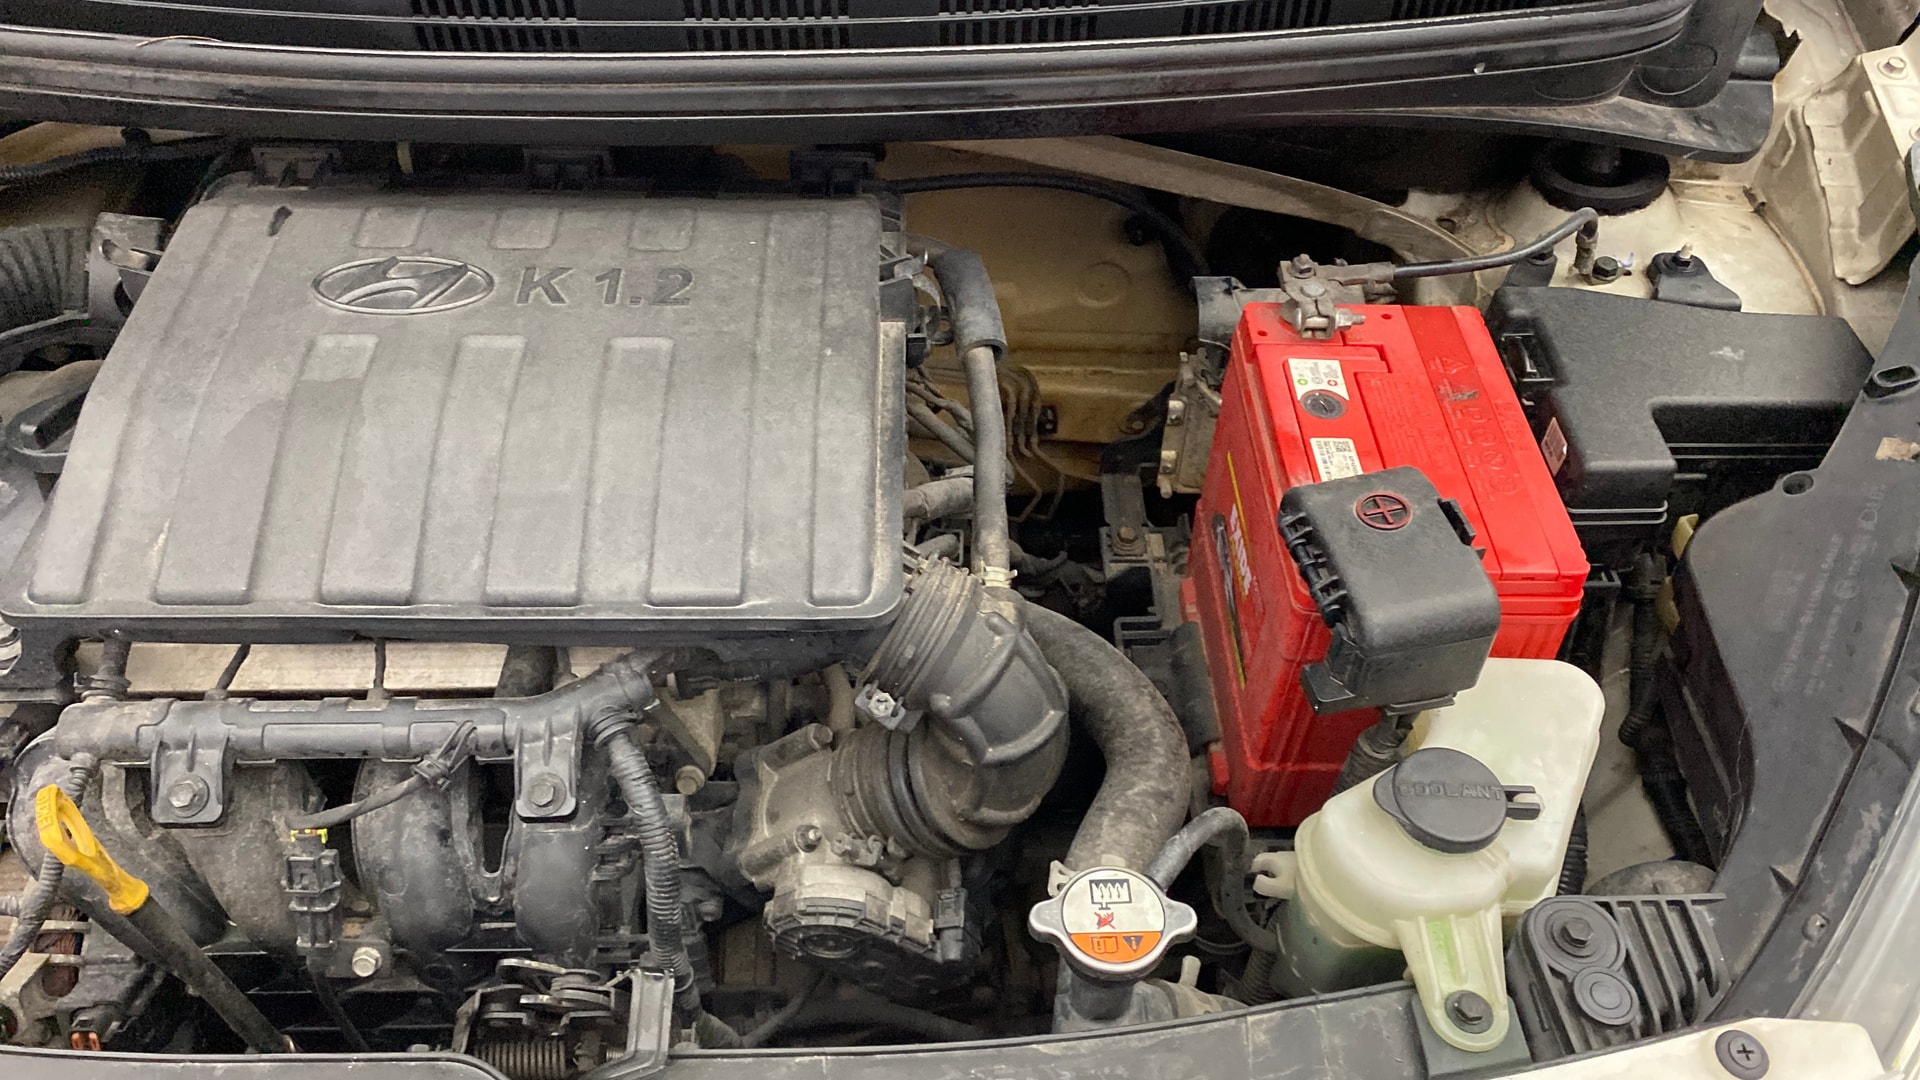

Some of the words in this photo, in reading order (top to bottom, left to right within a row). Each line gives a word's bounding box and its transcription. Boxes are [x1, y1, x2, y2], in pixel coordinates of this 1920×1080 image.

[515, 266, 574, 306] K
[593, 266, 693, 307] 1.2
[1399, 782, 1502, 801] COOLANT
